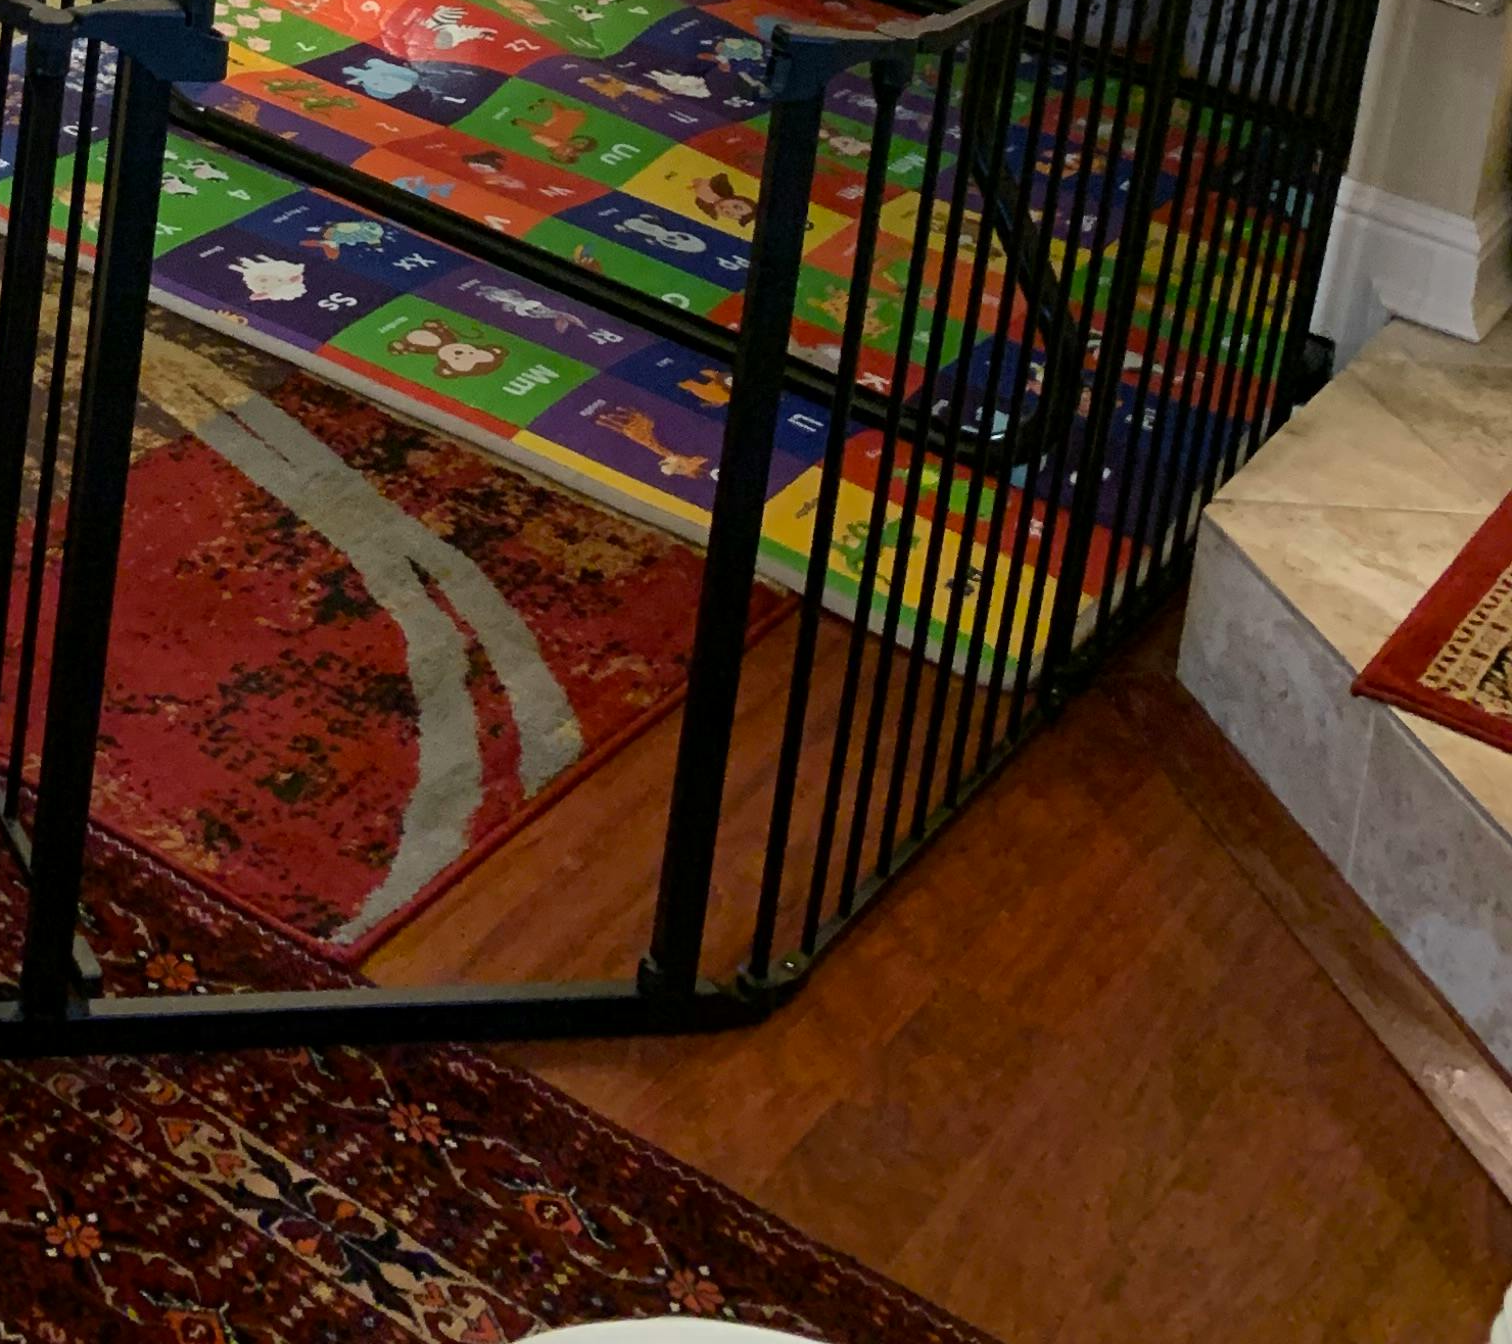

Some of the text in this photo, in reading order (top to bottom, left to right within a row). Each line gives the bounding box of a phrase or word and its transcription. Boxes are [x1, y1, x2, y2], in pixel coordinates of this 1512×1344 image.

[599, 142, 640, 166] Uu
[392, 251, 436, 271] Xx
[317, 292, 358, 312] Ss
[587, 328, 625, 346] Rr
[502, 363, 560, 397] Mm
